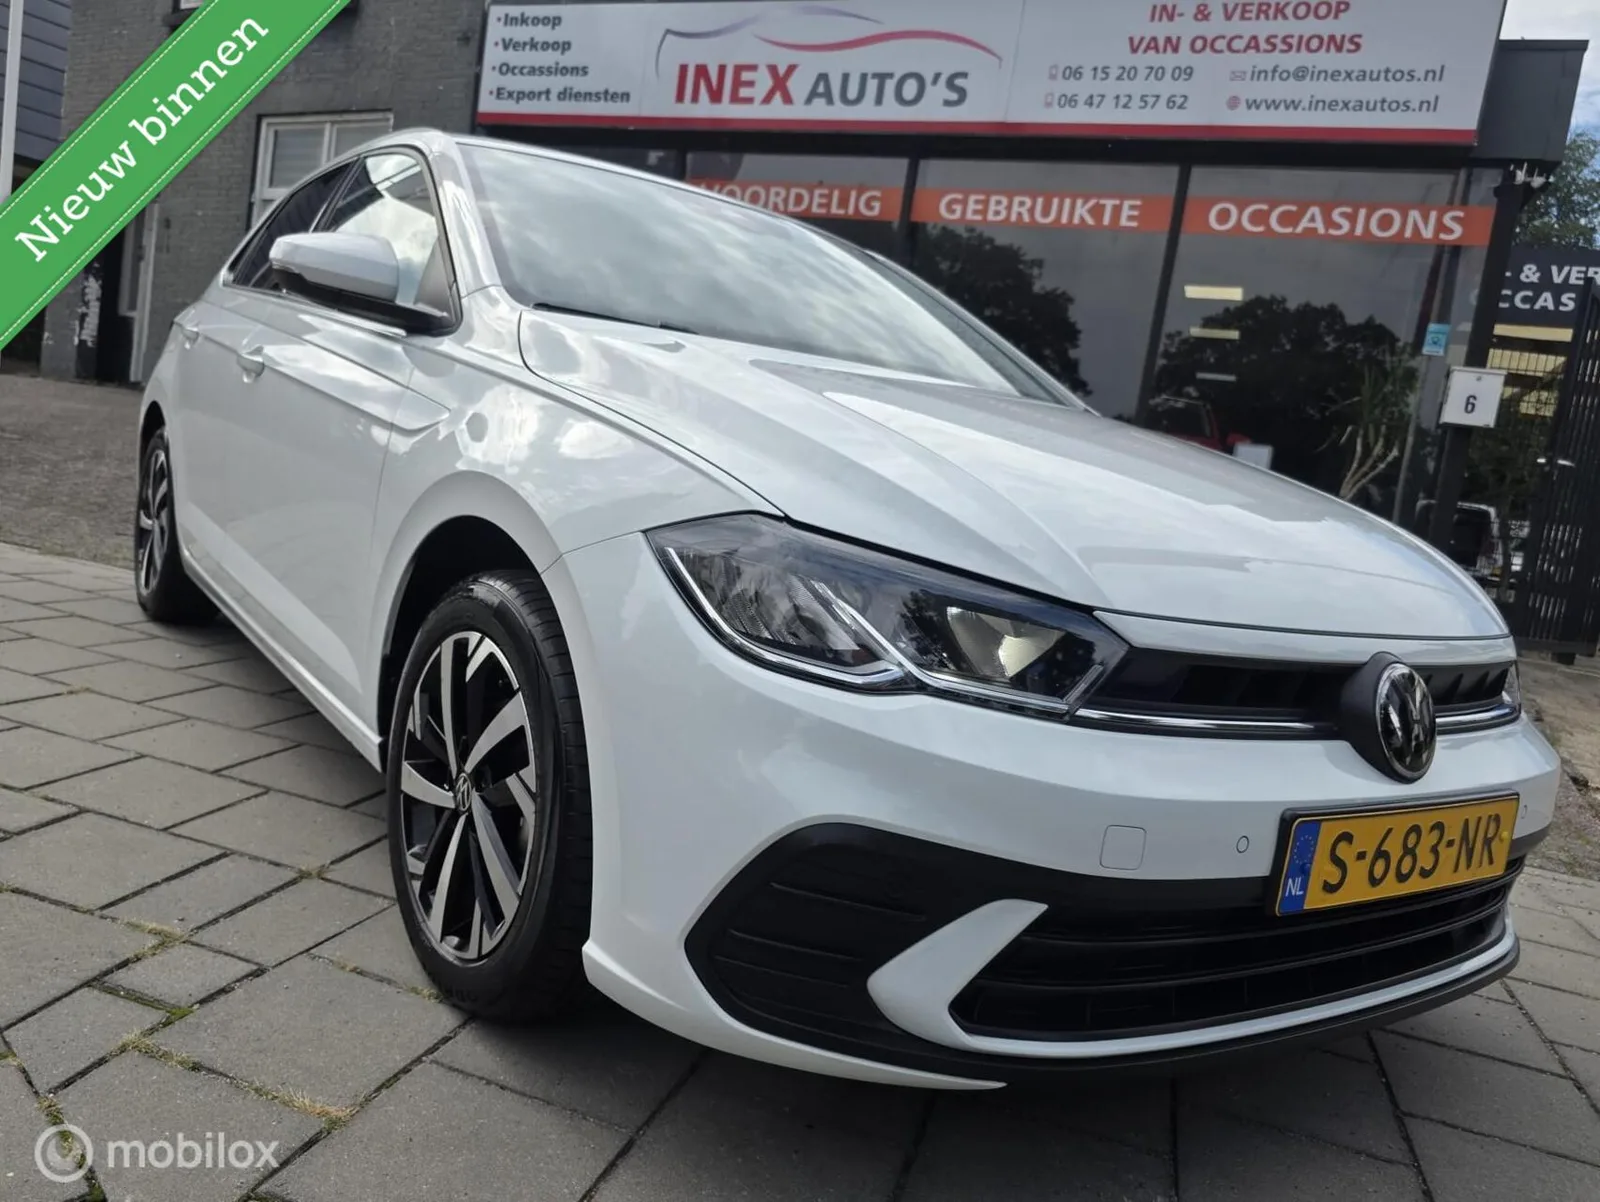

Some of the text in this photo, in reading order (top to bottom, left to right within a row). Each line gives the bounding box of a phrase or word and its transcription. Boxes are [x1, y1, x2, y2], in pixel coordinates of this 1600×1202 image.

[503, 12, 562, 30] Inkoop
[1150, 0, 1350, 23] IN- & VERKOOP
[501, 37, 572, 55] Verkoop
[1128, 34, 1363, 54] VAN OCCASSIONS
[498, 61, 589, 77] Occassions
[1062, 65, 1194, 81] 06 15 20 70 09
[1249, 64, 1445, 82] info@inexautos.nl
[674, 63, 969, 107] INEX AUTO'S
[495, 86, 631, 104] Export diensten
[1057, 94, 1188, 110] 06 47 12 57 62
[1245, 95, 1439, 113] www.inexautos.nl
[938, 193, 1142, 227] GEBRUIKTE
[1208, 202, 1465, 240] OCCASIONS
[1519, 264, 1541, 283] &
[1464, 394, 1477, 414] 6
[1321, 813, 1502, 894] S-683-NR
[1285, 876, 1304, 897] NL
